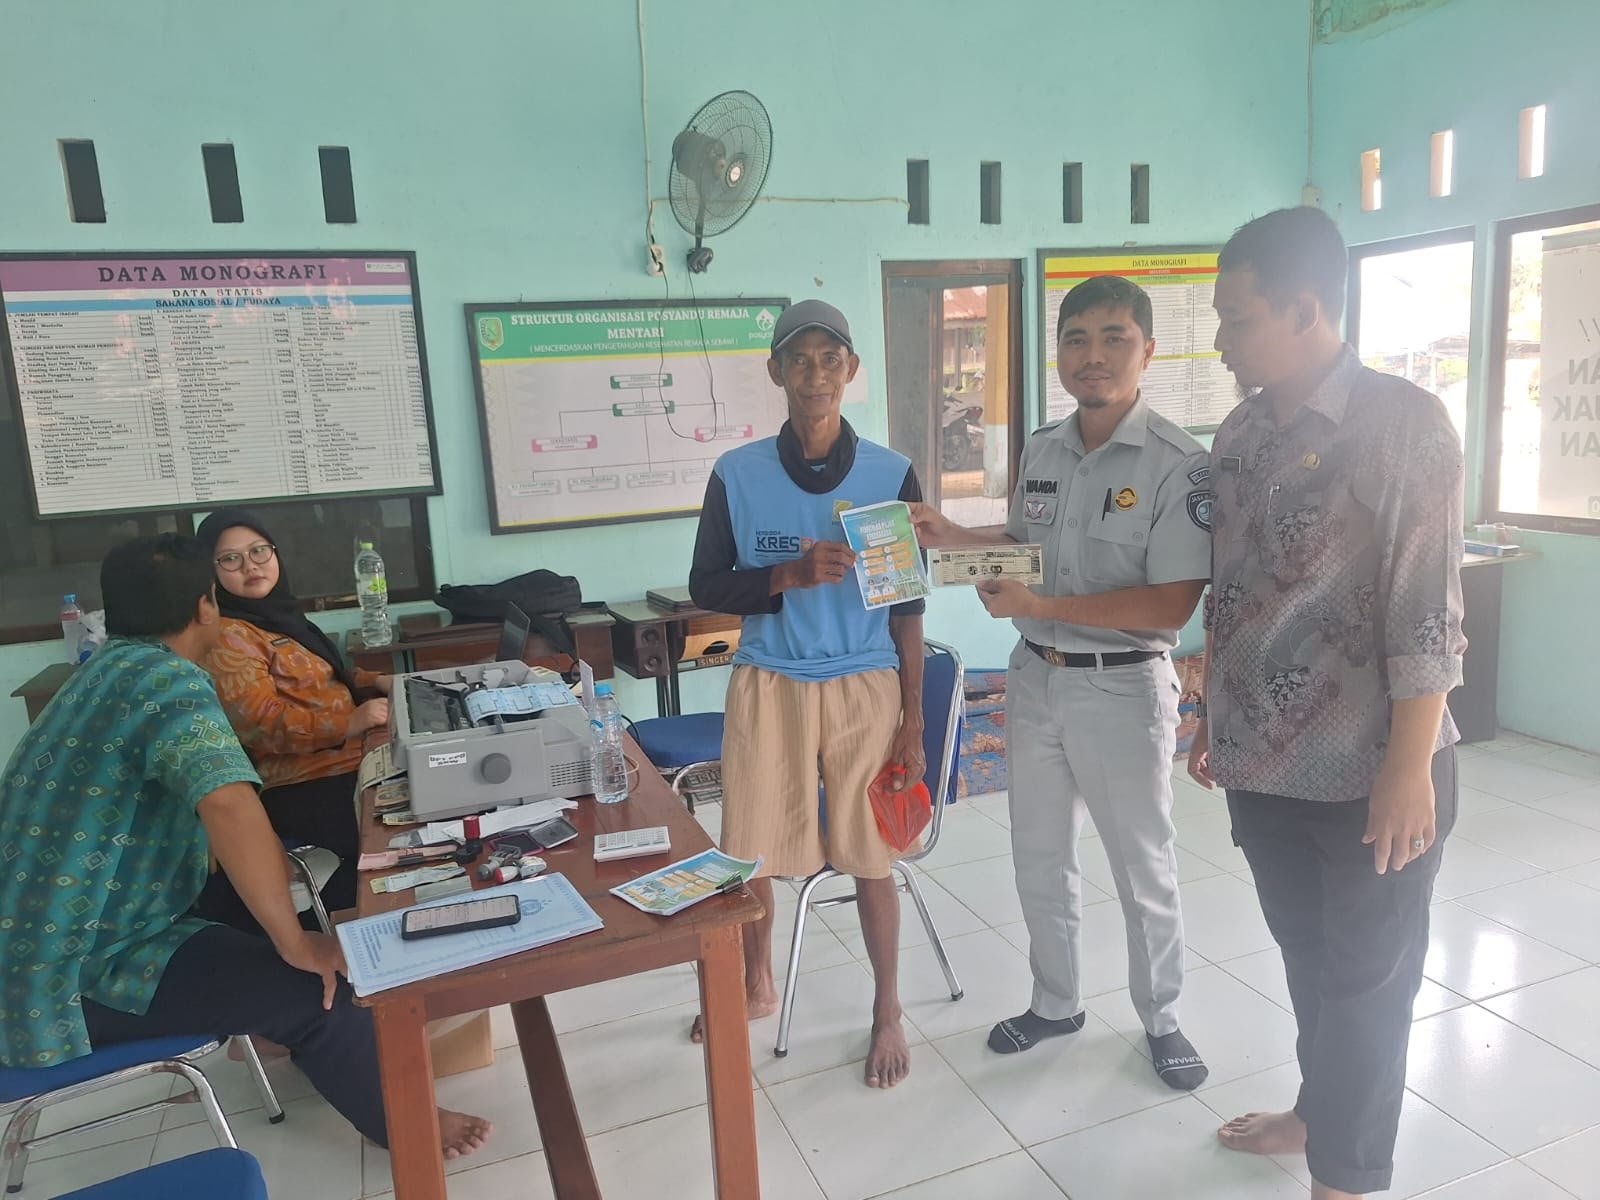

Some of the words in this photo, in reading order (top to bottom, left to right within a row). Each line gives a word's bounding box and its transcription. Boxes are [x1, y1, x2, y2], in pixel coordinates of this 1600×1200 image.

[98, 266, 166, 282] DATA
[180, 264, 326, 281] MONOGRAFI
[172, 289, 208, 297] DATA
[216, 288, 263, 297] STATIS
[511, 313, 574, 326] STRUKTUR
[576, 310, 645, 324] ORGANISASI
[647, 308, 704, 321] POSYANDU
[707, 307, 750, 320] REMAJA
[607, 327, 665, 340] MENTARI
[1026, 479, 1058, 494] WANDA
[699, 655, 729, 666] SINGER
